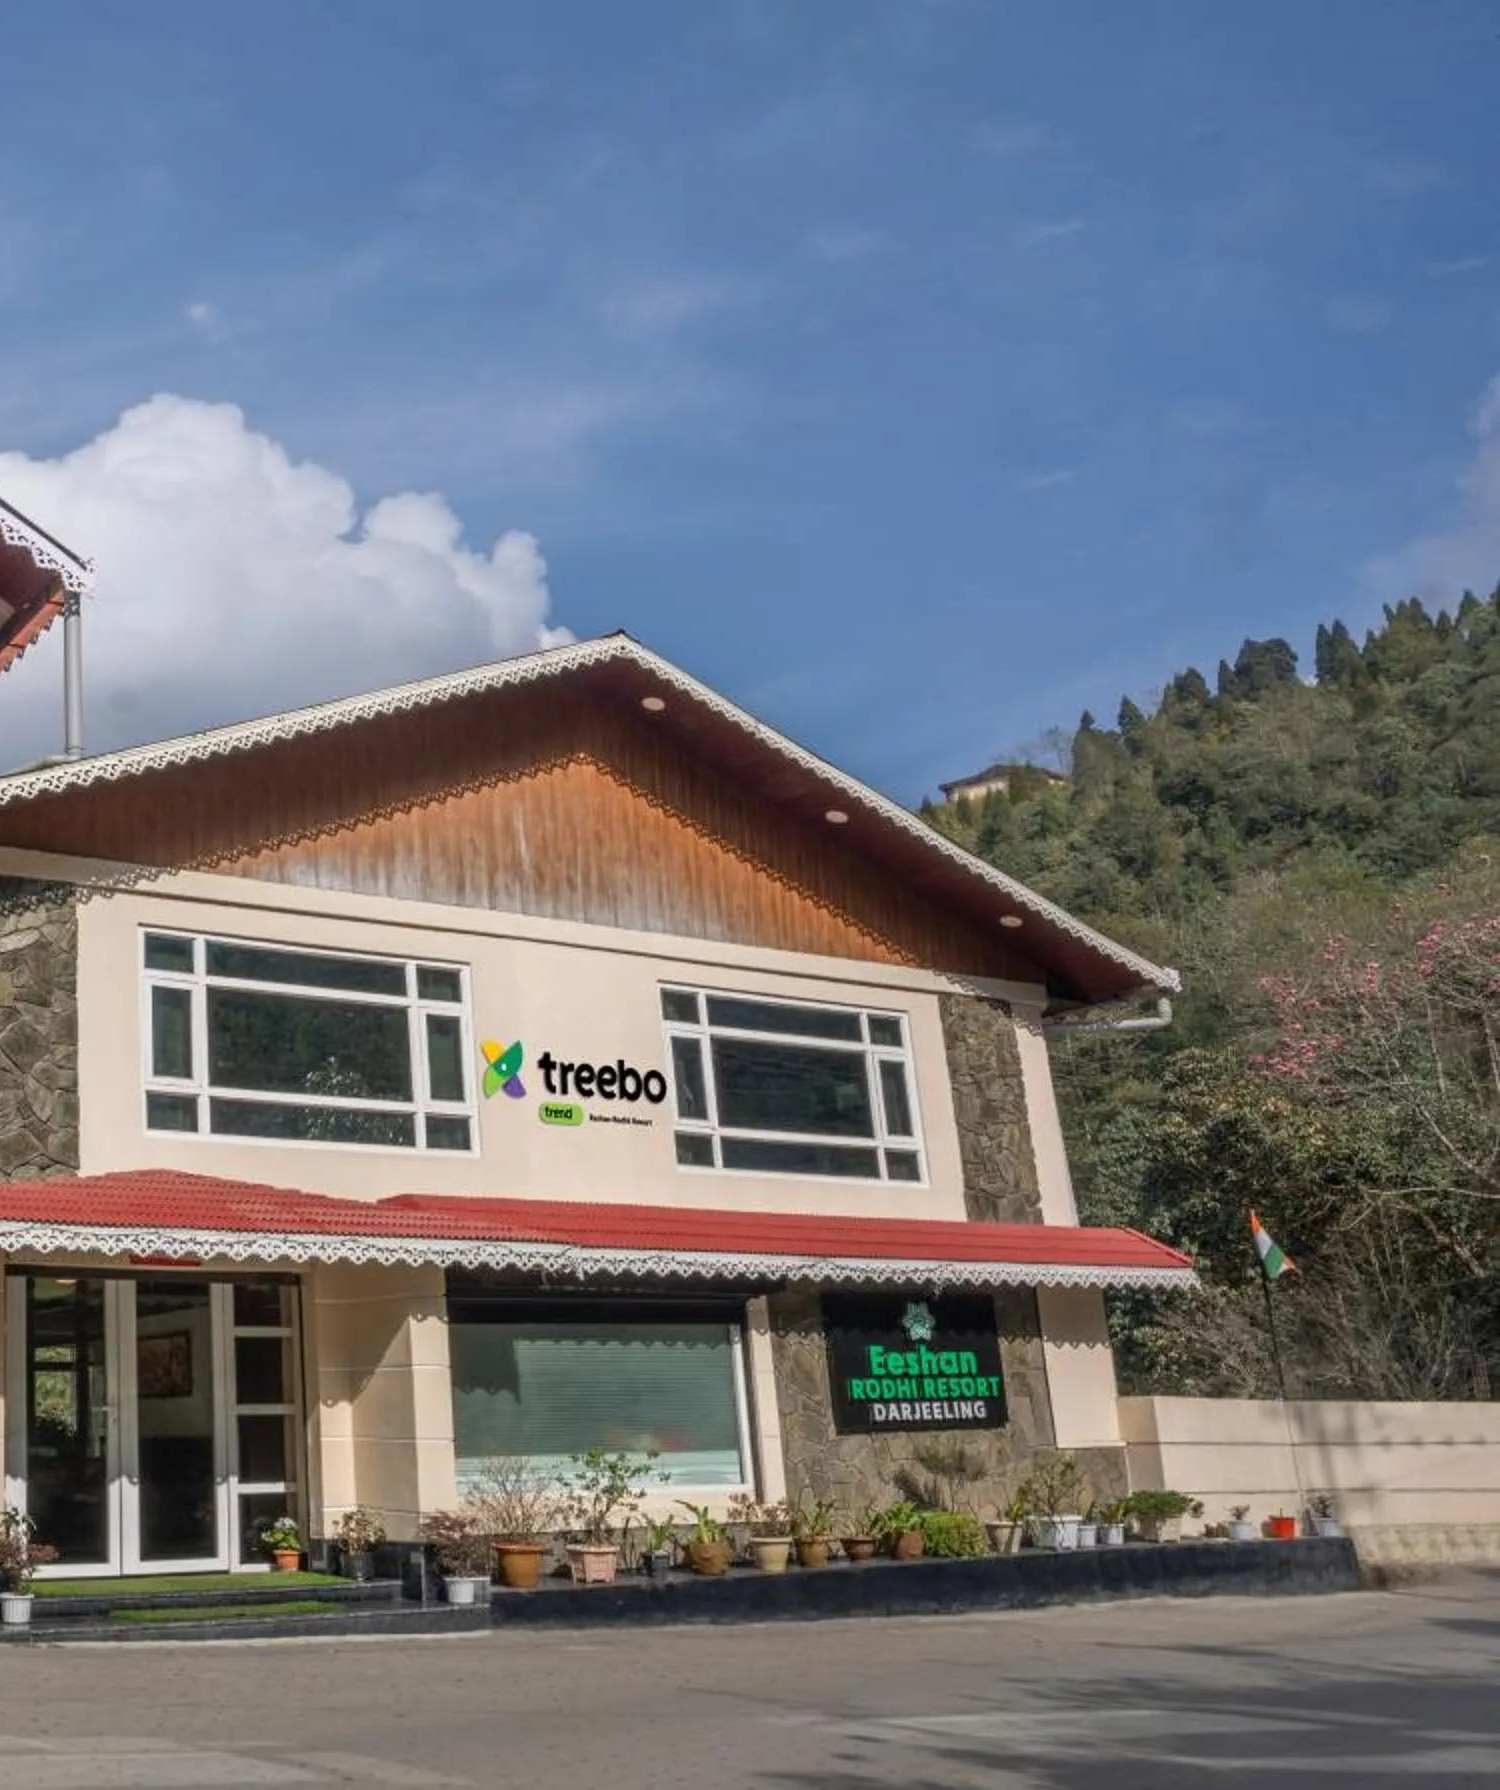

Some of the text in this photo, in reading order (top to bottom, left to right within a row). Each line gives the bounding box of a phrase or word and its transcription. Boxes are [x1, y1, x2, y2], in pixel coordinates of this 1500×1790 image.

[538, 1051, 667, 1104] treebo
[544, 1107, 574, 1120] trend
[869, 1344, 978, 1376] Eeshan
[850, 1376, 1000, 1400] RODHI RESORT
[873, 1401, 988, 1421] DARJEELING
